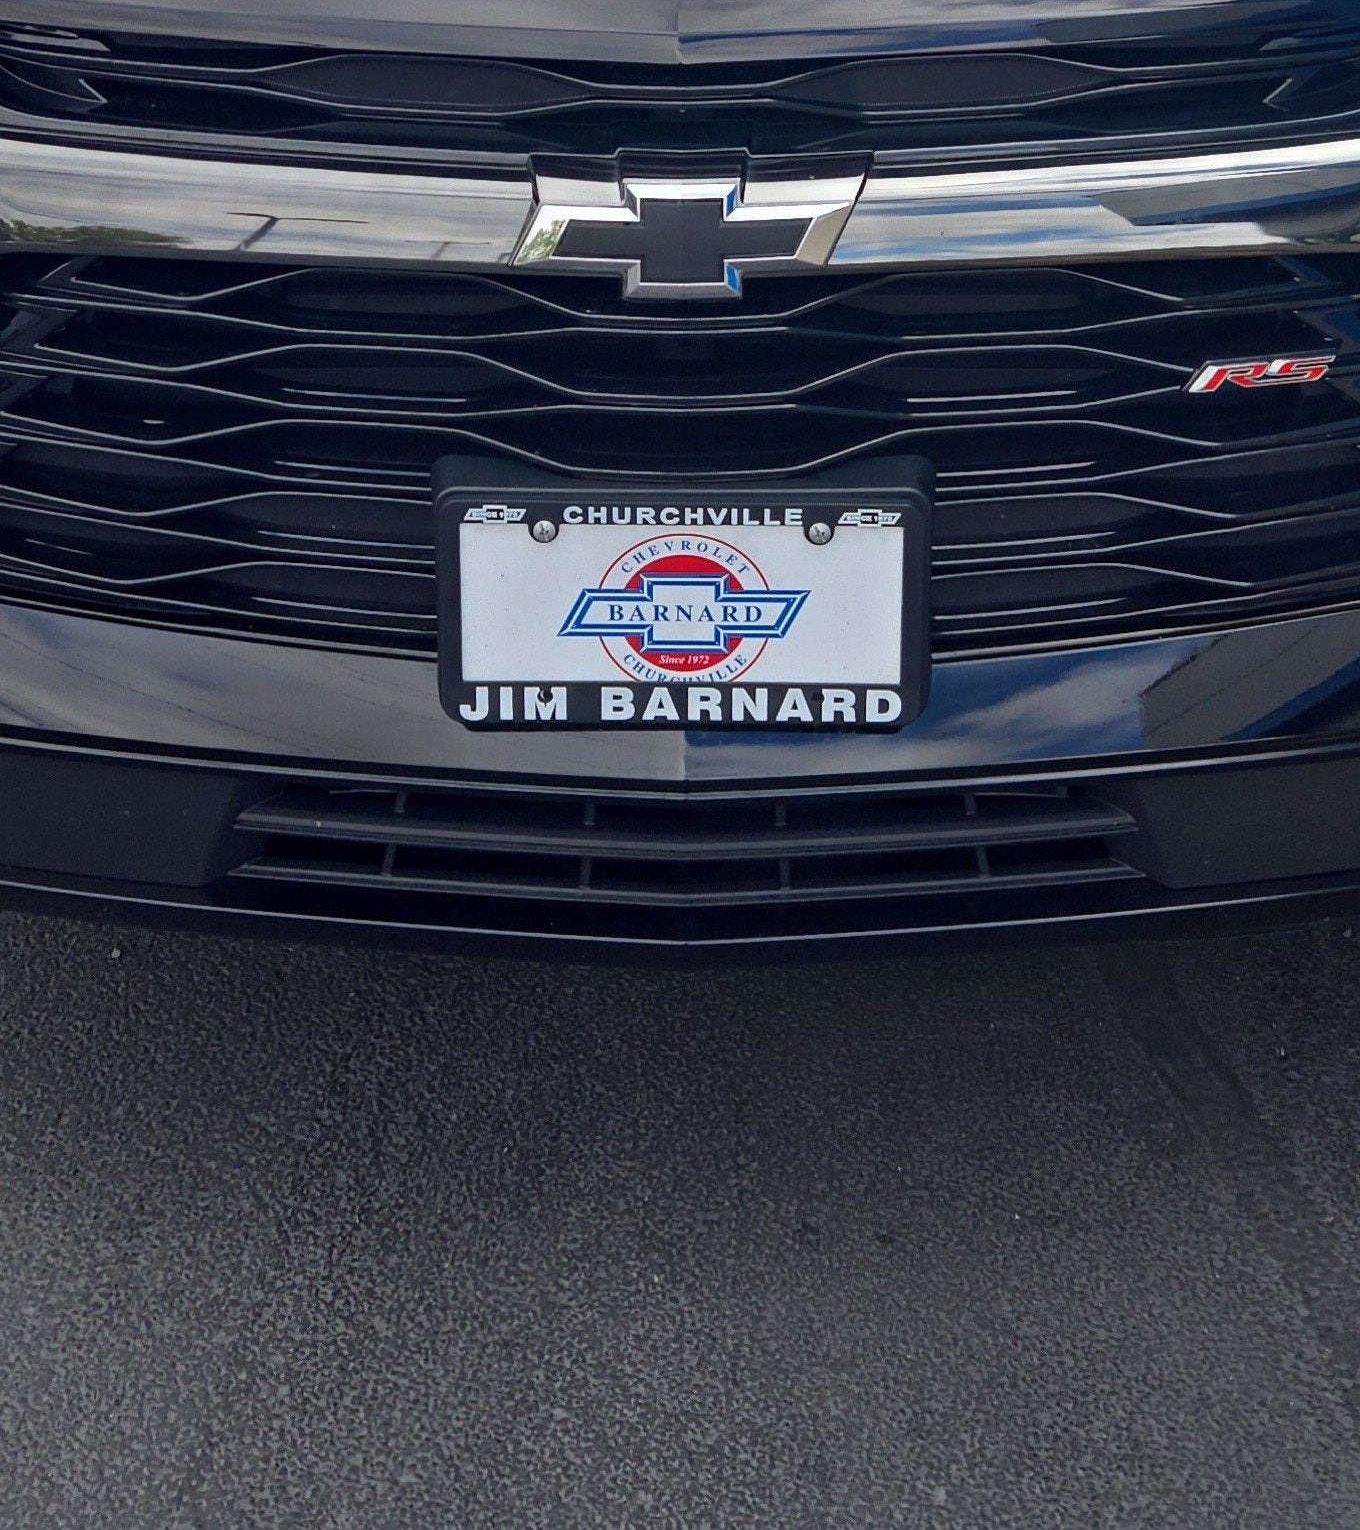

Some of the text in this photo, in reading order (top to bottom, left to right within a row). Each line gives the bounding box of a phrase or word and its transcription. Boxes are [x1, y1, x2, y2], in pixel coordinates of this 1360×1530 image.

[1189, 354, 1337, 393] RS
[562, 505, 803, 527] CHURCHVILLE
[621, 540, 750, 575] CHEVROLET
[607, 603, 763, 622] BARNARD
[658, 654, 710, 665] Since 1972
[460, 686, 903, 724] JIM BARNARD
